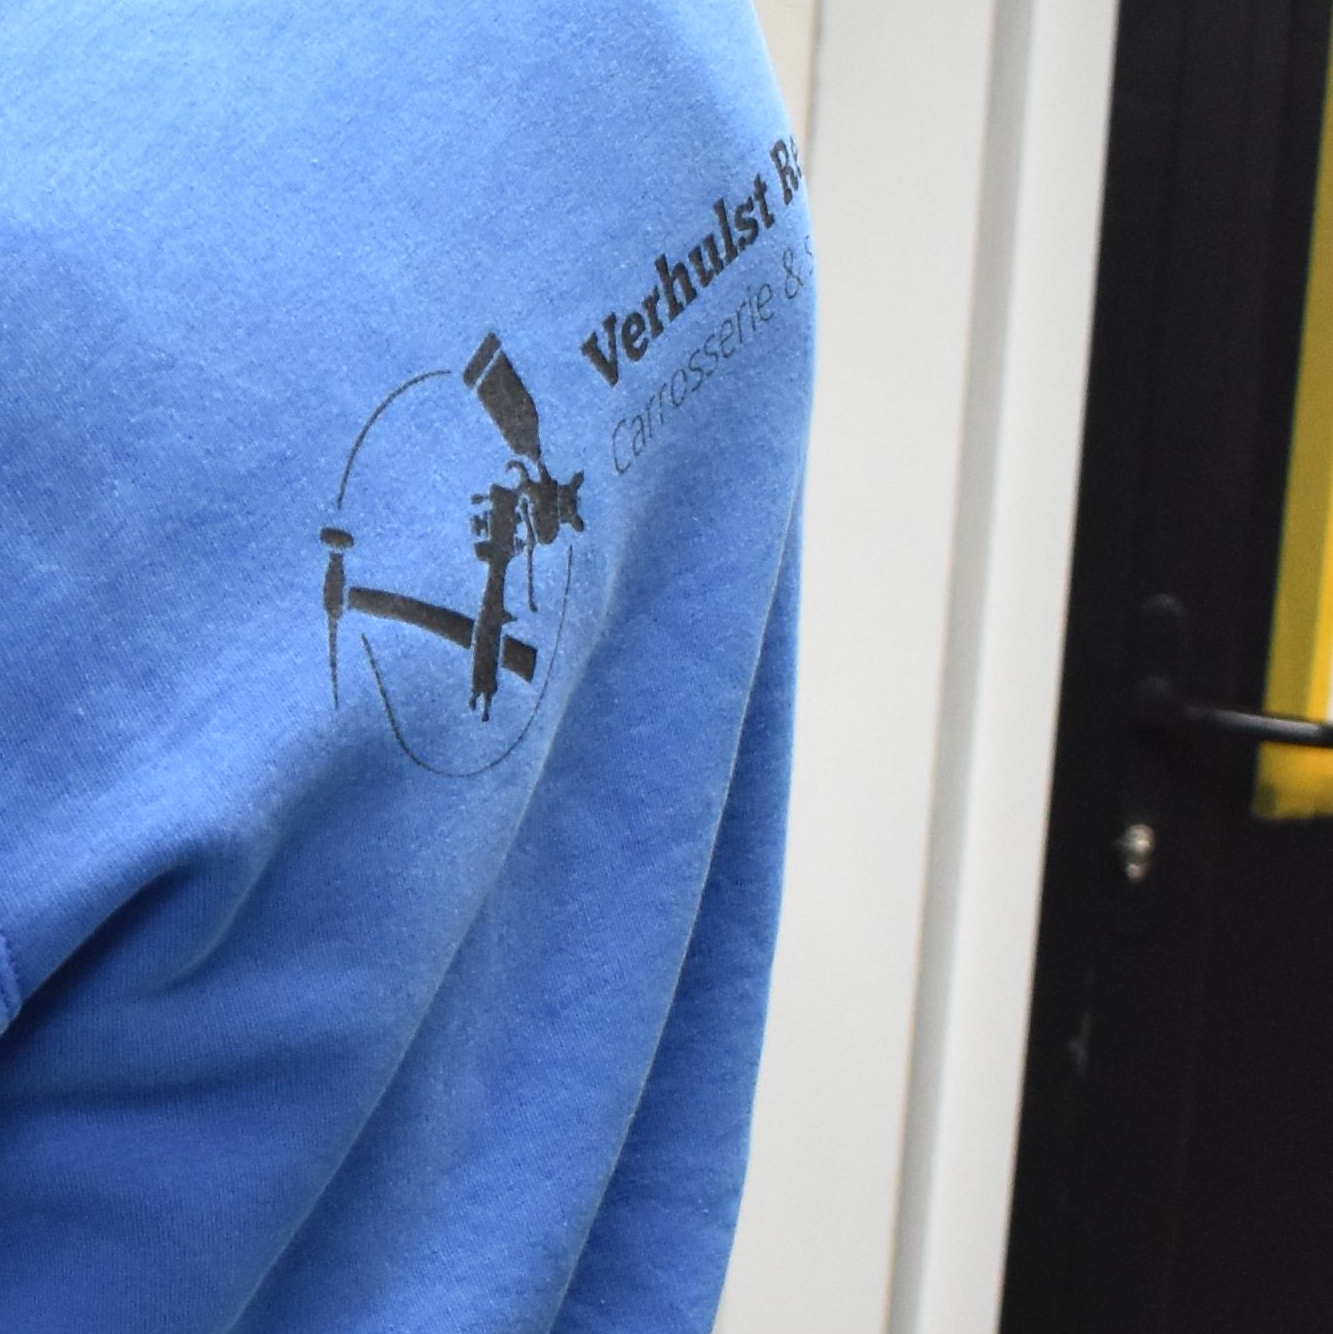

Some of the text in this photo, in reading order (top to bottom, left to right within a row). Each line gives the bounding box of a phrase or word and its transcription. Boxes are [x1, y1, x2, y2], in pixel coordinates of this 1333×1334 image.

[580, 171, 775, 388] Verhulst
[610, 247, 804, 477] Carrosserie &
